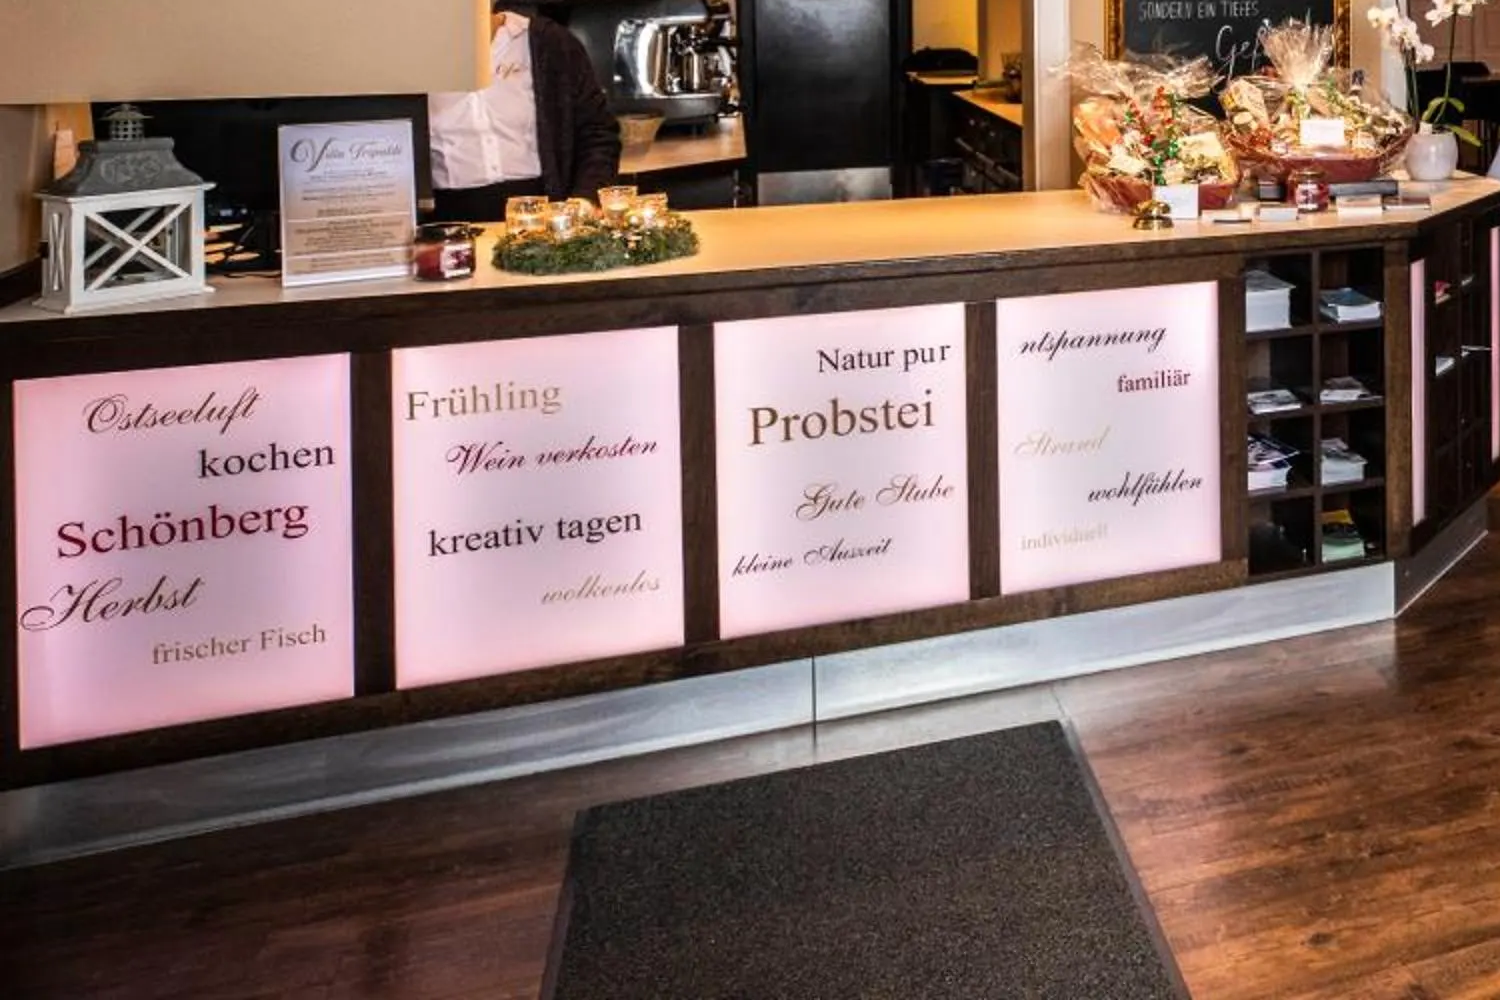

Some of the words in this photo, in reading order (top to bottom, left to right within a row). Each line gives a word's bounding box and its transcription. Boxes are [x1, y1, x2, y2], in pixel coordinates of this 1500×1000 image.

[816, 348, 895, 373] Natur
[902, 344, 951, 372] pur
[404, 381, 563, 421] Frühling
[1117, 369, 1192, 393] familiär
[83, 386, 260, 435] Ostseeluft
[748, 389, 936, 447] Probstei
[199, 442, 336, 480] kochen
[446, 441, 526, 476] Wein
[535, 435, 658, 467] verkosten
[795, 482, 866, 521] Gute
[875, 474, 955, 506] Stube
[1087, 468, 1203, 506] wohlfühlen
[57, 503, 310, 559] Schönberg
[427, 519, 544, 557] kreativ
[557, 512, 643, 543] tagen
[731, 555, 794, 578] kleine
[803, 537, 893, 566] Auszeit
[20, 575, 206, 632] Herbst
[540, 569, 661, 606] wolkenlos
[152, 634, 252, 665] frischer
[259, 623, 327, 650] Fisch
